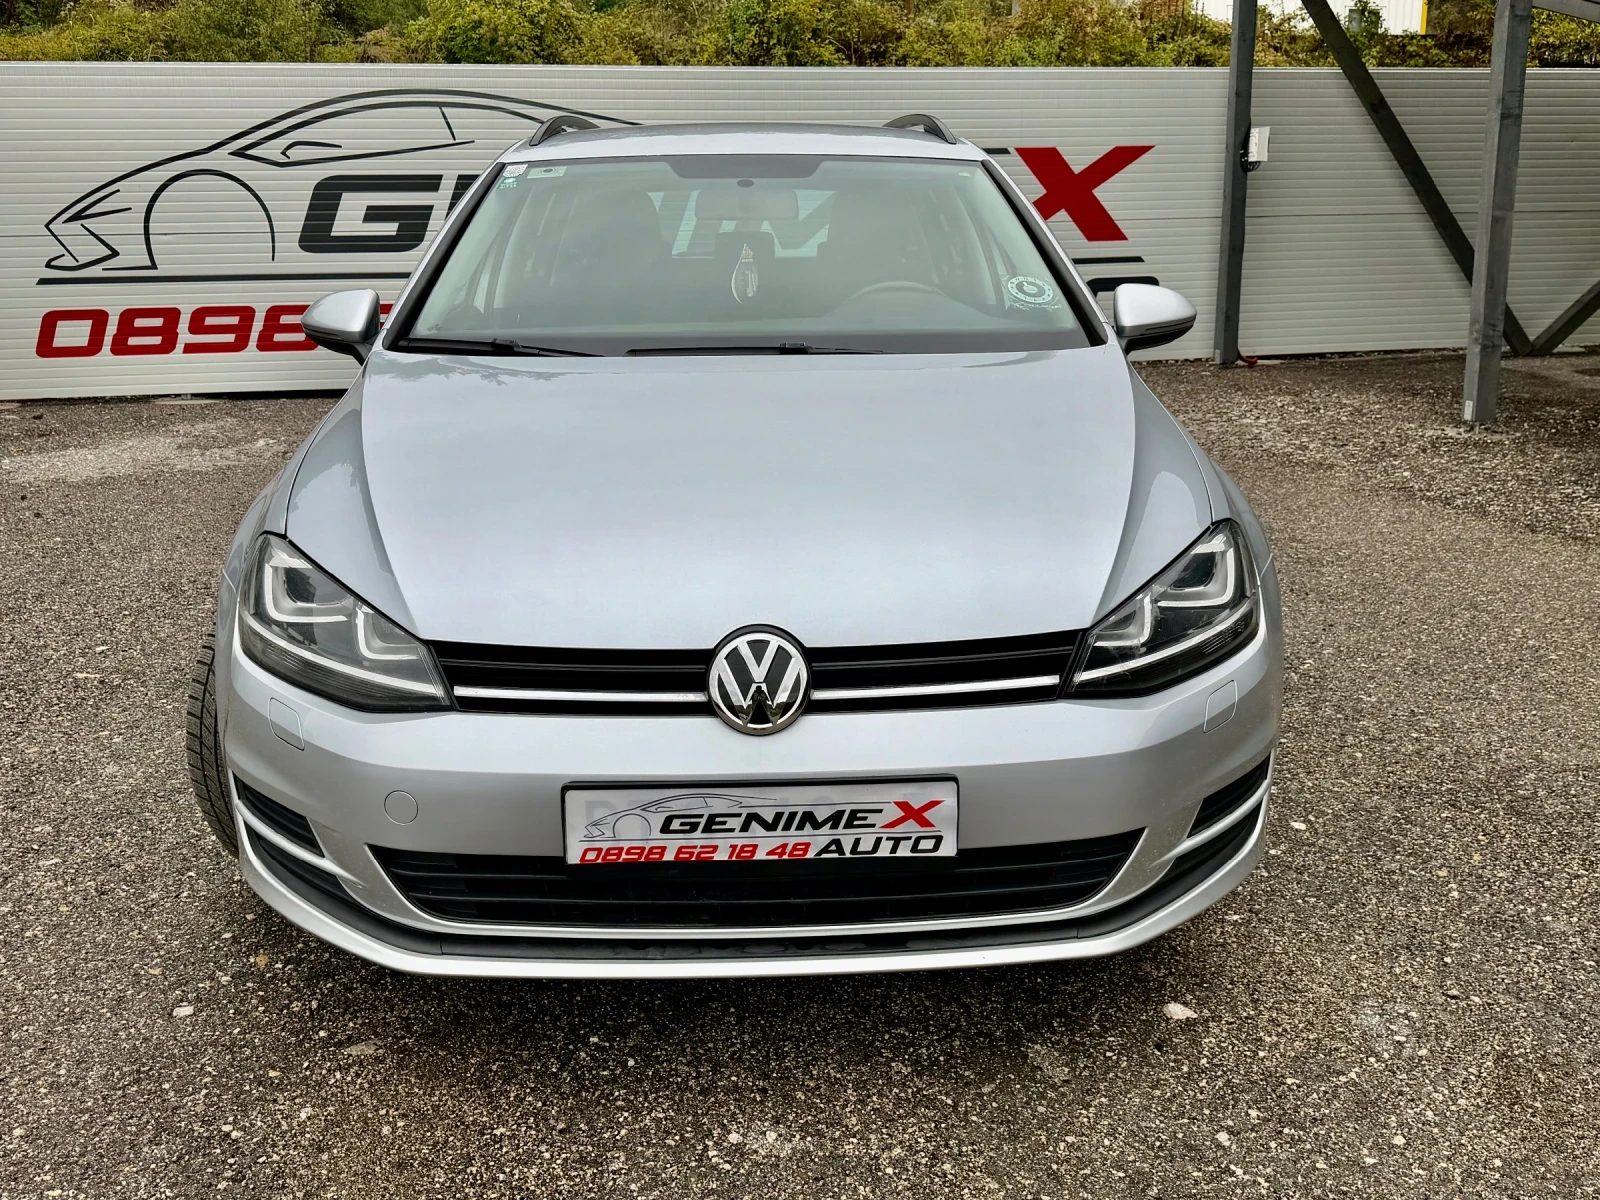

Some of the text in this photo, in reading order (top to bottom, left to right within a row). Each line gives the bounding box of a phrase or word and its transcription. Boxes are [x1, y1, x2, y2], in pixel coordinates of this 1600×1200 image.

[659, 800, 946, 835] GENIMEX
[578, 835, 944, 864] 0898 62 18 48 AUTO
